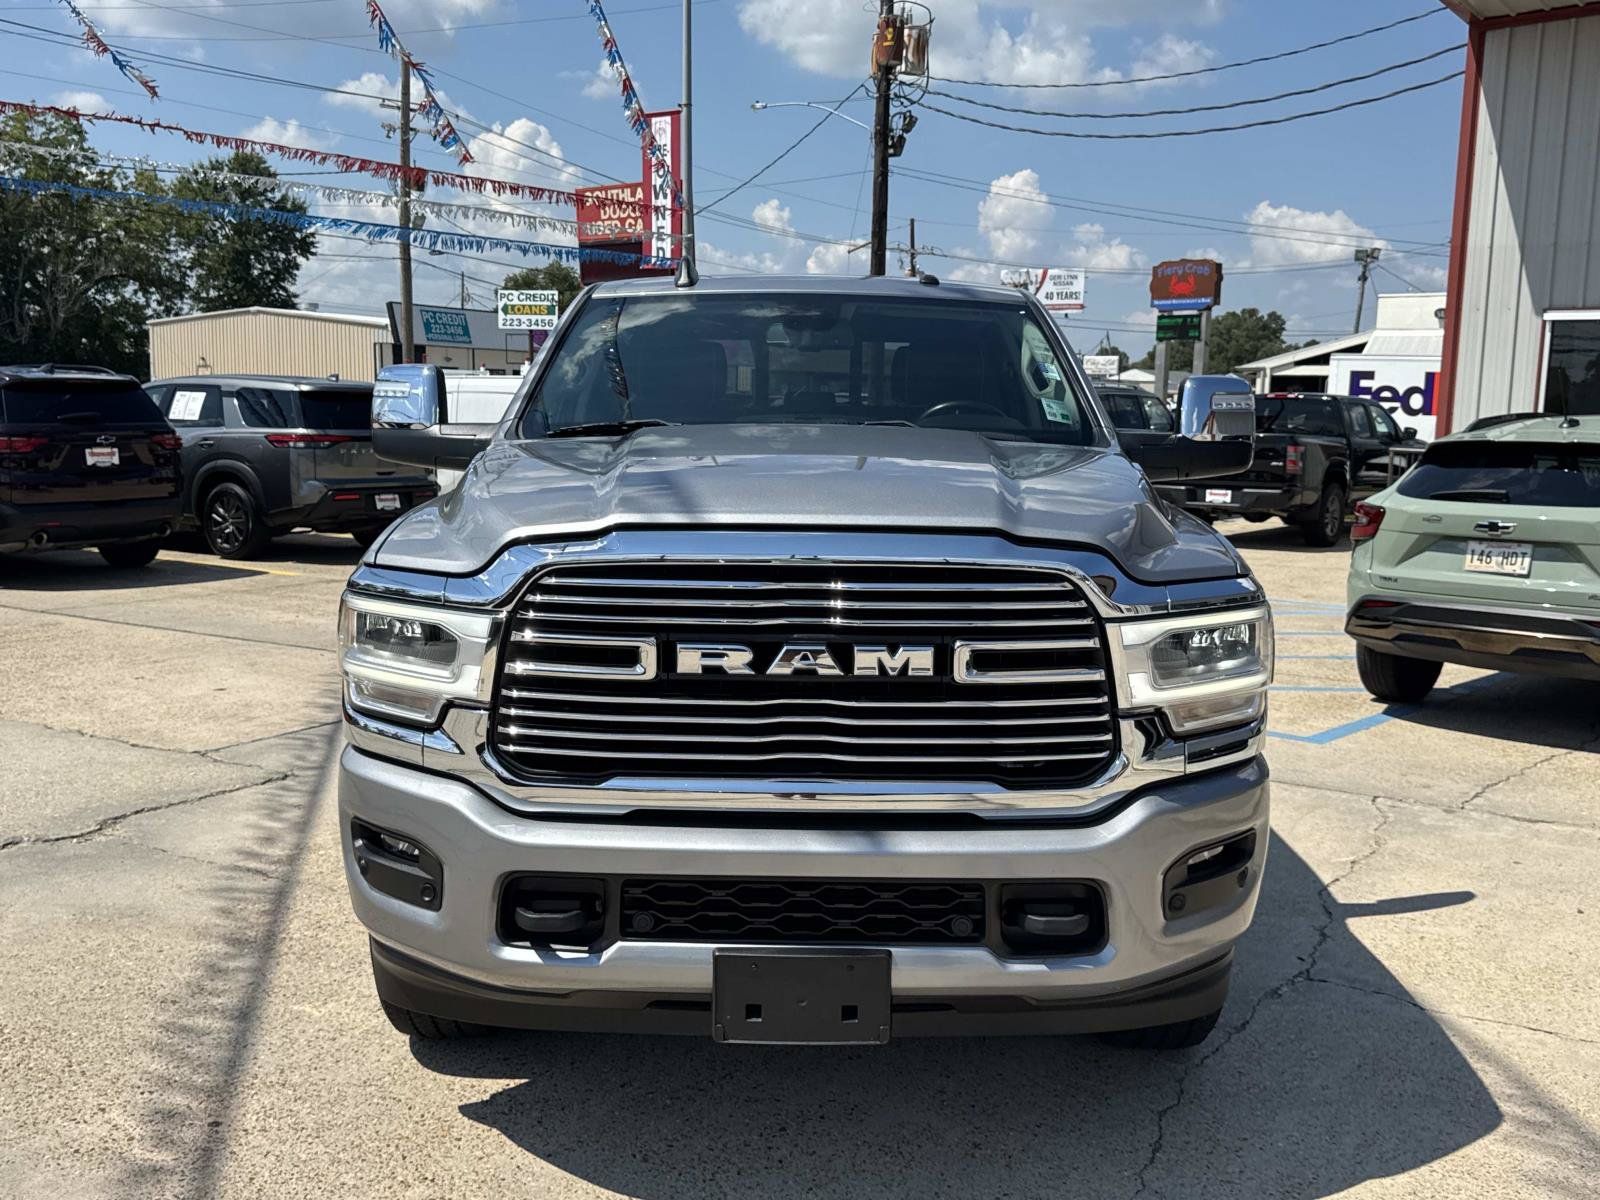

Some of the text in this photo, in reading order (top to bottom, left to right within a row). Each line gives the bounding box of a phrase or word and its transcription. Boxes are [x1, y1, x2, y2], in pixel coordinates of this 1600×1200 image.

[500, 292, 557, 303] PC CREDIT
[1045, 291, 1054, 300] 40
[508, 304, 548, 315] LOANS
[422, 311, 466, 326] PC CREDIT
[502, 318, 554, 328] 223-3456
[1469, 550, 1528, 566] 146 HDT
[677, 642, 934, 676] RAM
